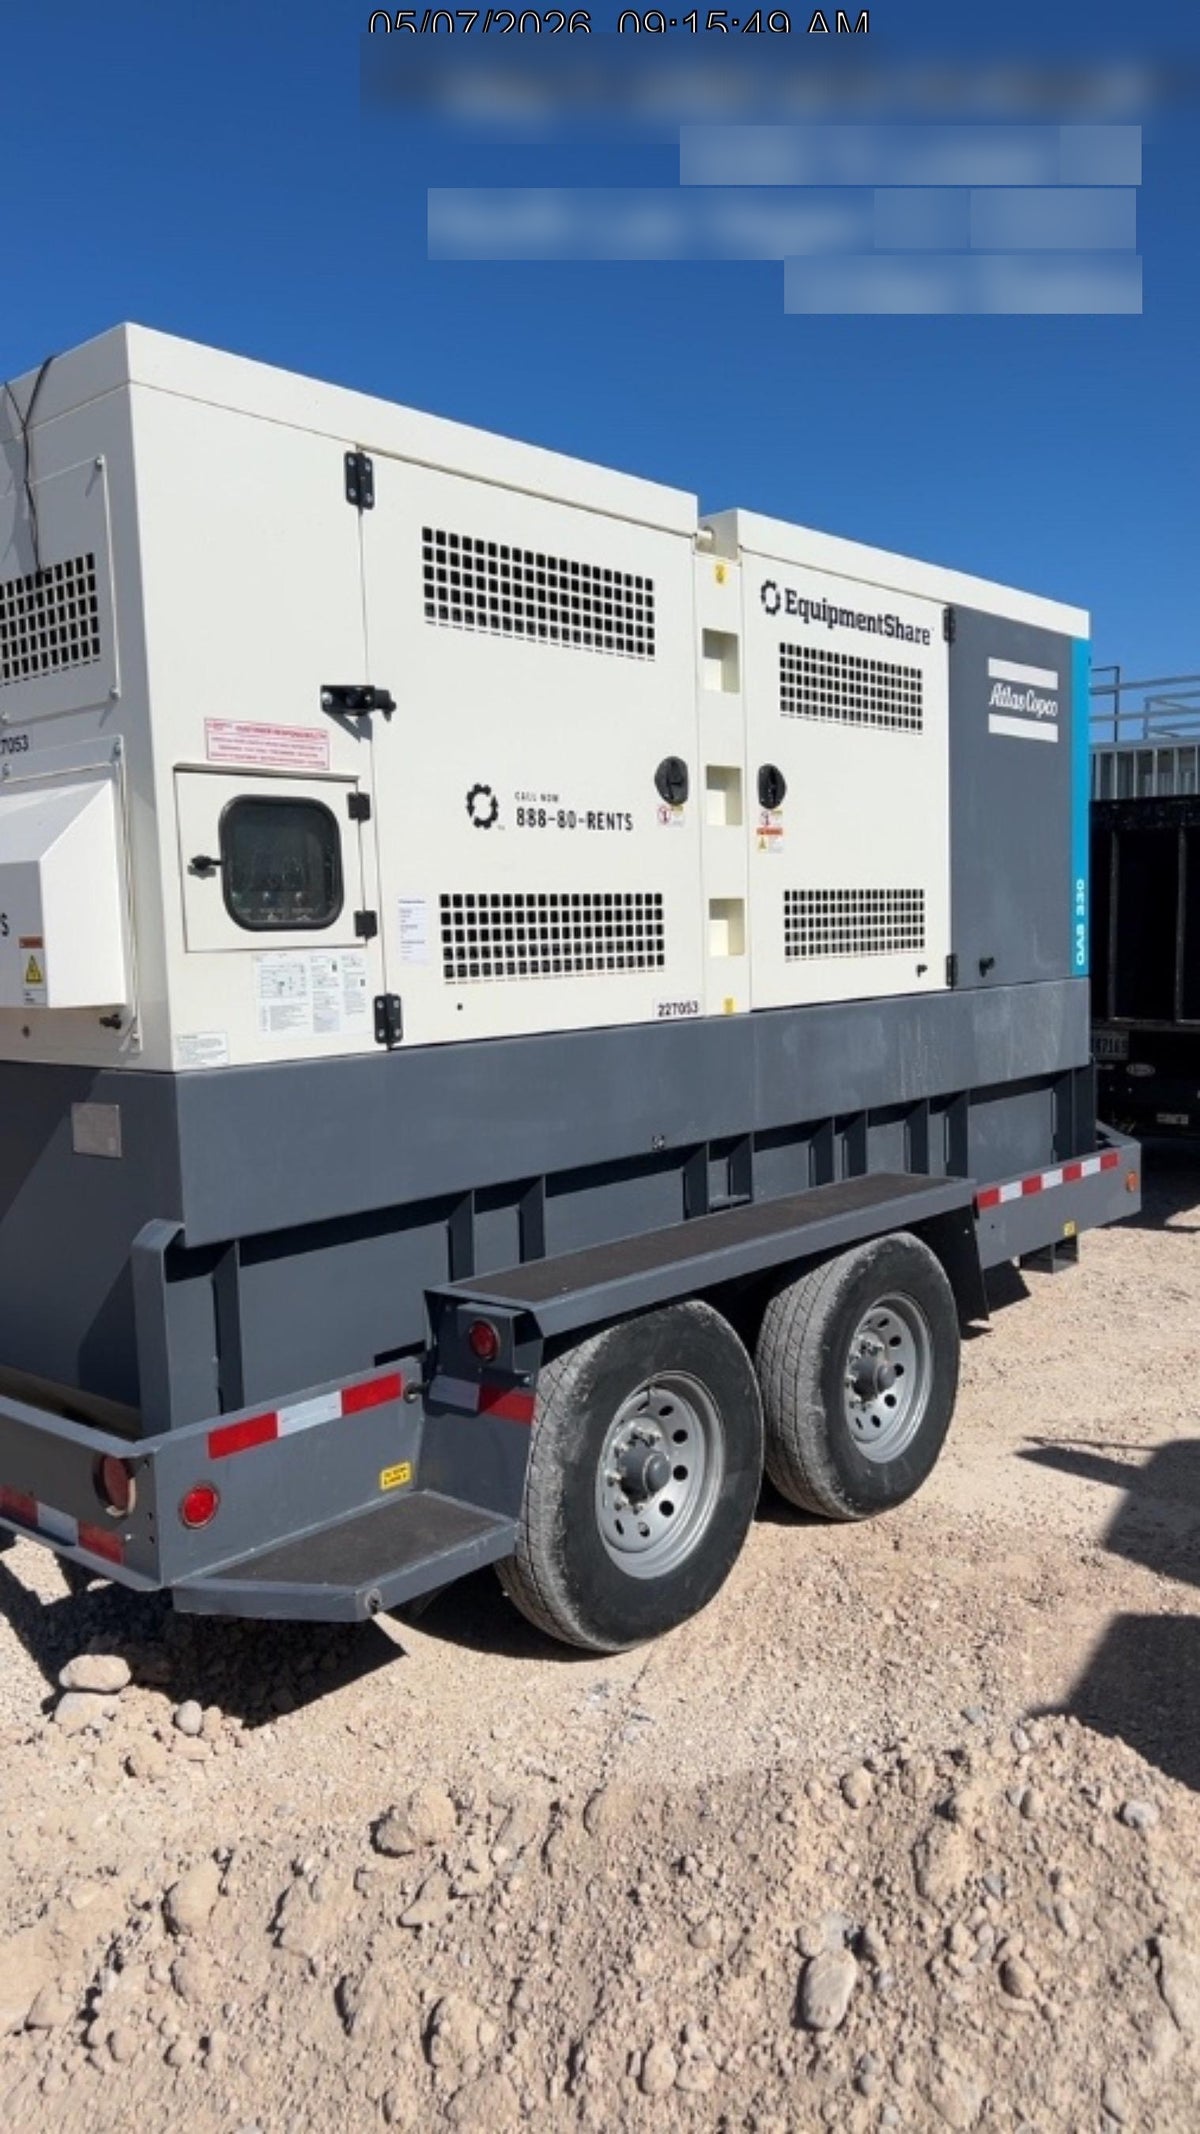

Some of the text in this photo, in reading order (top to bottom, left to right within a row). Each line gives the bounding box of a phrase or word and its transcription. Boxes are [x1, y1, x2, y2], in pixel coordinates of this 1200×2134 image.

[785, 588, 931, 645] EquipmentShare
[988, 682, 1059, 719] Atlas Copco
[514, 791, 559, 802] CALL NOW
[516, 807, 633, 831] 888-80-RENTS
[1076, 879, 1085, 966] QAS 330
[658, 1000, 698, 1017] 227053
